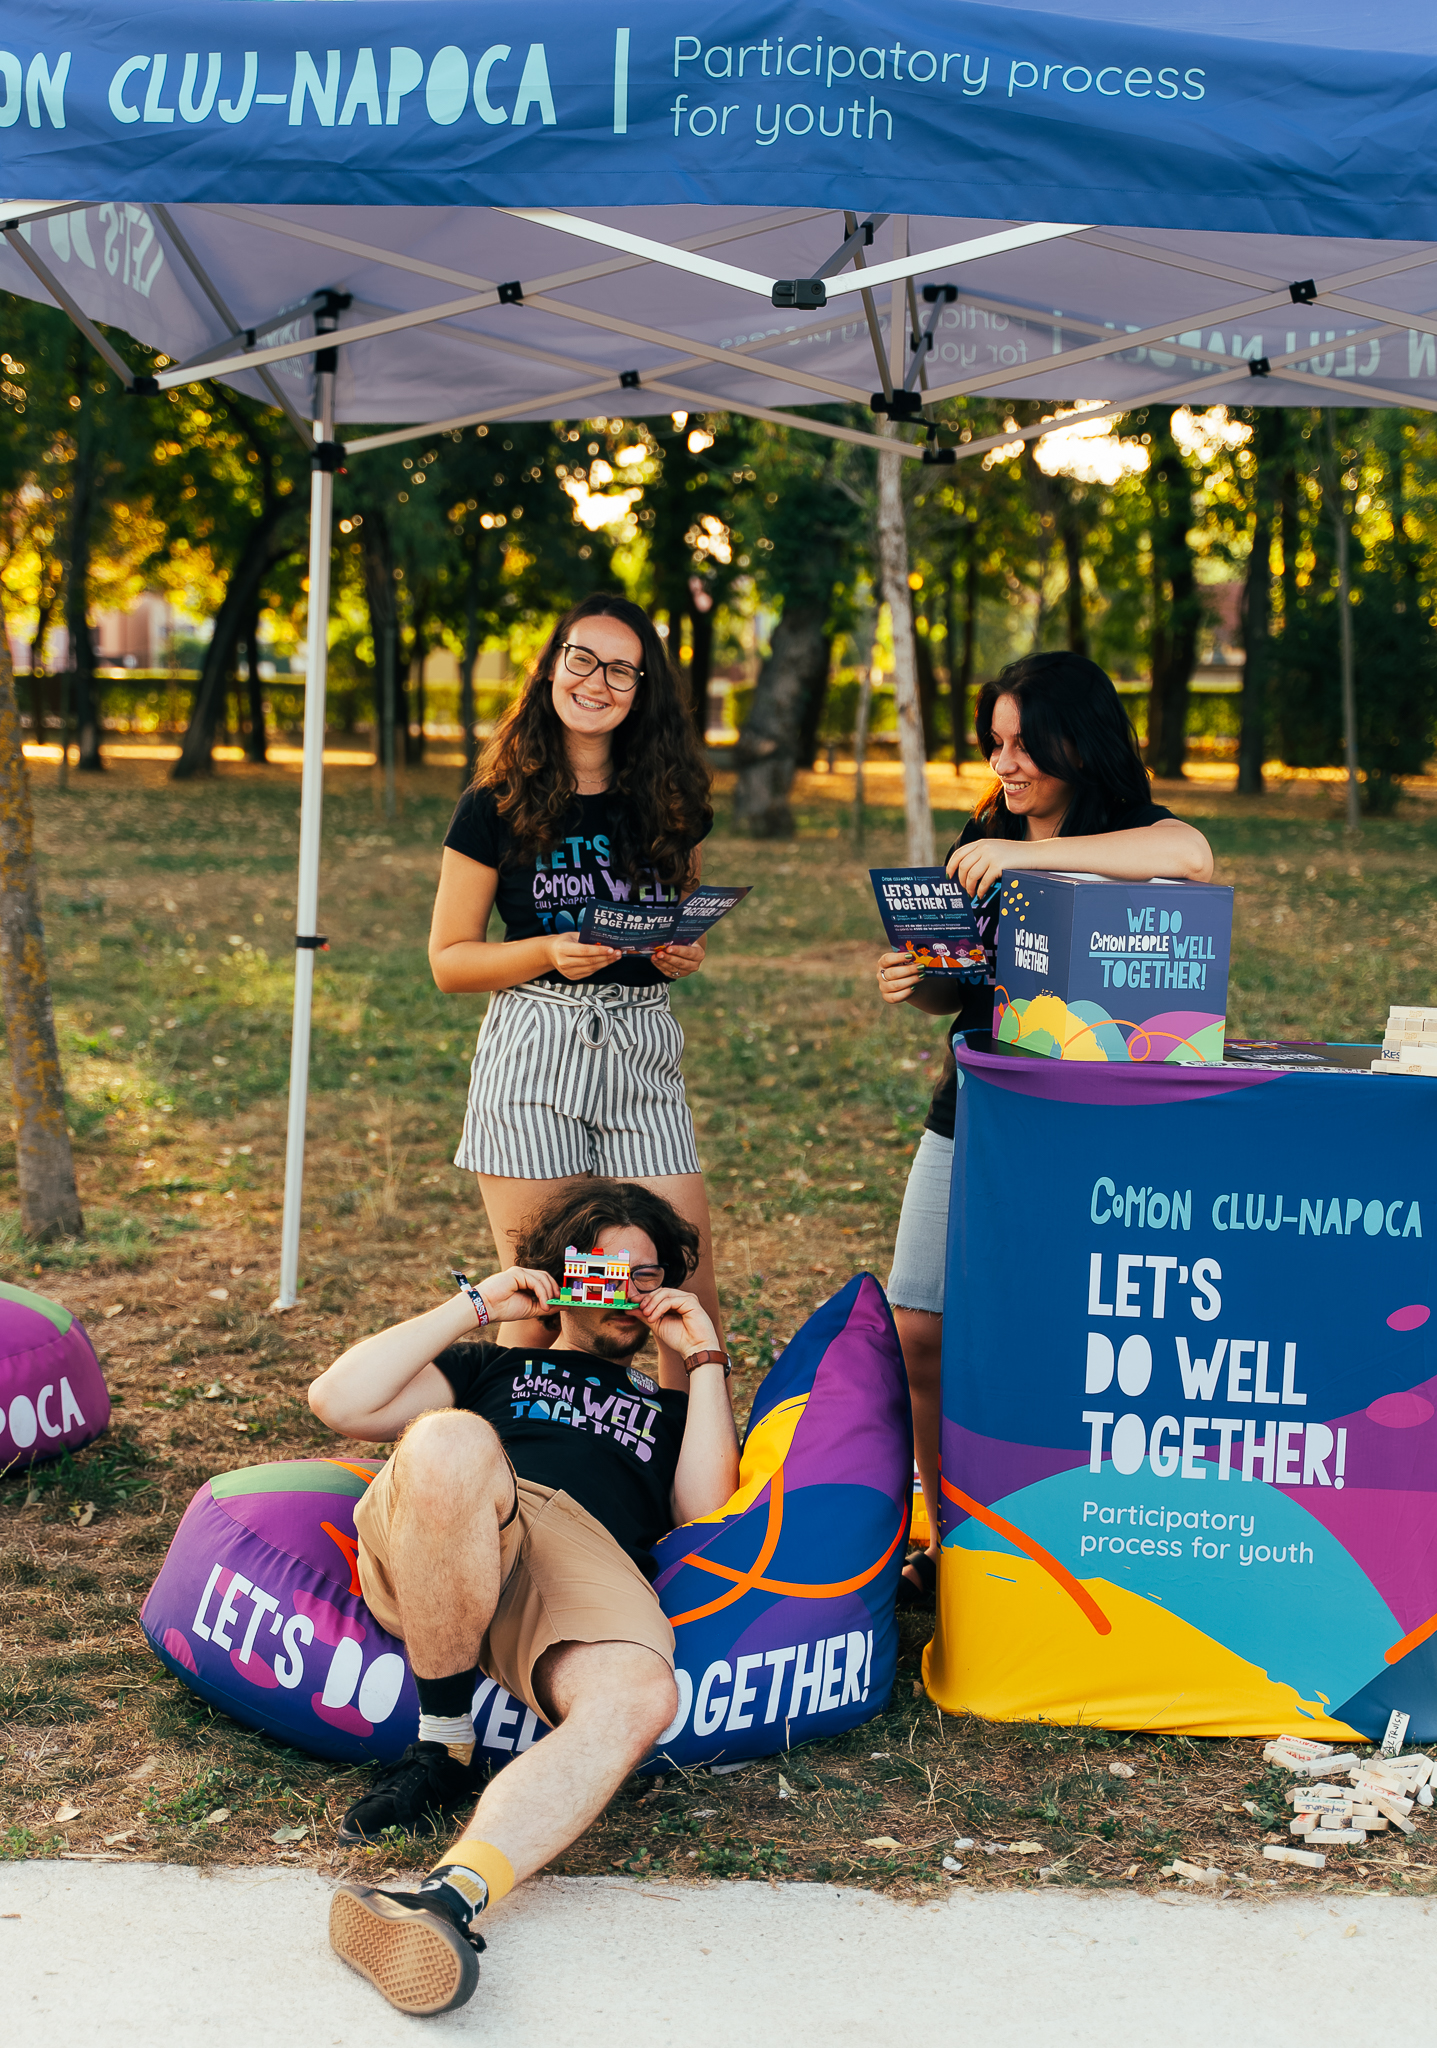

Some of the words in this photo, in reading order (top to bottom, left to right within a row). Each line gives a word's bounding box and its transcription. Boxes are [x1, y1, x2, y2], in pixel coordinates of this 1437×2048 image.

[108, 43, 557, 126] CLUJ-NAPOCA
[673, 35, 990, 97] Participatory
[1008, 57, 1206, 102] process
[671, 93, 740, 138] for
[755, 95, 893, 147] youth
[882, 884, 912, 898] LET'S
[914, 883, 930, 897] DO
[931, 883, 963, 897] WELL
[885, 897, 948, 911] TOGETHER!
[593, 916, 655, 931] TOGETHER!
[594, 908, 625, 921] LET'S
[626, 913, 643, 923] DO
[646, 914, 675, 923] WELL
[1127, 907, 1156, 933] WE
[1159, 910, 1183, 934] DO
[1015, 928, 1025, 945] WE
[1025, 931, 1034, 948] DO
[1034, 933, 1049, 953] WELL
[1128, 935, 1169, 953] PEOPLE
[1172, 935, 1216, 960] WELL
[1014, 946, 1049, 976] TOGETHER!
[1101, 959, 1207, 991] TOGETHER!
[1211, 1192, 1423, 1238] CLUJ-NAPOCA
[1087, 1252, 1222, 1322] LET'S
[1084, 1331, 1153, 1397] DO
[1175, 1336, 1308, 1406] WELL
[583, 1386, 657, 1445] WELL
[1082, 1410, 1348, 1490] TOGETHER!
[1082, 1501, 1255, 1536] Participatory
[1080, 1532, 1183, 1559] process
[1190, 1536, 1230, 1560] for
[1238, 1540, 1315, 1566] youth
[191, 1562, 314, 1690] LET'S
[320, 1635, 404, 1724] DO
